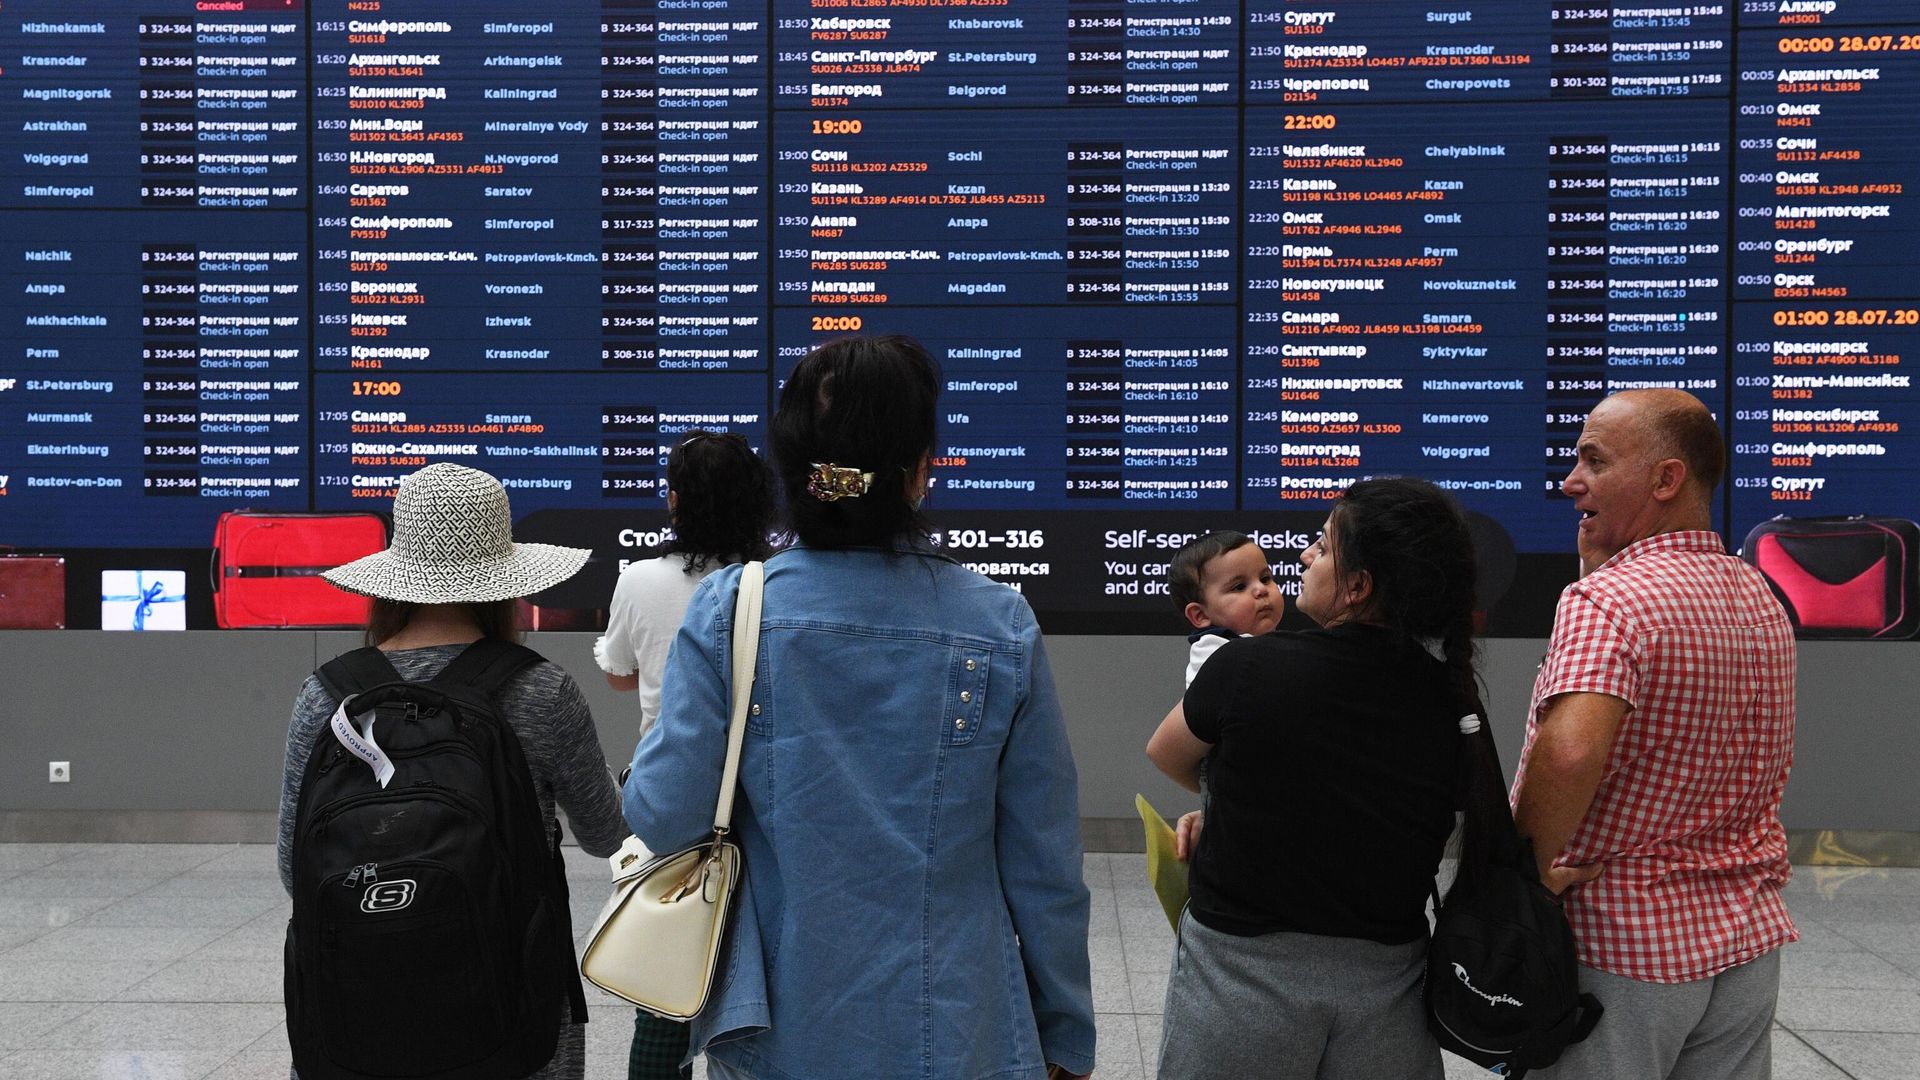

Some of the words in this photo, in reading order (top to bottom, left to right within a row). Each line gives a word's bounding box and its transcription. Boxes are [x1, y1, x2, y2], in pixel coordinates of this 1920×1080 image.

[196, 1, 243, 10] Cancelled
[1779, 0, 1836, 14] Алжир
[1203, 17, 1231, 25] 14:30
[1285, 11, 1335, 25] Сургут
[1427, 11, 1471, 23] Surgut
[22, 23, 105, 33] Nizhnekamsk
[152, 25, 192, 33] 324-364
[197, 23, 267, 34] Регистрация
[271, 25, 296, 33] идет
[317, 22, 345, 31] 16:15
[349, 20, 451, 34] Симферополь
[484, 23, 552, 35] Simferopol
[613, 24, 653, 32] 324-364
[659, 22, 729, 32] Регистрация
[733, 22, 758, 31] идет
[779, 19, 808, 28] 18:30
[811, 17, 890, 31] Хабаровск
[949, 19, 1023, 29] Khabarovsk
[197, 34, 238, 43] Check-in
[241, 36, 266, 44] open
[658, 33, 700, 41] Check-in
[703, 34, 727, 42] open
[1427, 45, 1494, 55] Krasnodar
[1779, 38, 1834, 52] 00:00
[811, 49, 937, 64] Санкт-Петербург
[949, 52, 1036, 63] St.Petersburg
[1285, 45, 1367, 61] Краснодар
[23, 56, 87, 65] Krasnodar
[349, 54, 440, 67] Архангельск
[484, 56, 562, 68] Arkhangelsk
[1564, 77, 1606, 87] 301-302
[1777, 69, 1879, 83] Архангельск
[812, 84, 882, 97] Белгород
[1284, 79, 1369, 92] Череповец
[1426, 78, 1510, 91] Cherepovets
[23, 89, 111, 100] Magnitogorsk
[350, 86, 446, 100] Калининград
[485, 89, 556, 100] Kaliningrad
[949, 85, 1006, 97] Belgorod
[1777, 103, 1820, 115] Омск
[23, 121, 86, 130] Astrakhan
[350, 119, 423, 133] Мин.Воды
[485, 121, 554, 133] Mineralnye
[558, 121, 588, 133] Vody
[813, 120, 862, 134] 19:00
[1285, 115, 1336, 129] 22:00
[1777, 137, 1816, 149] Сочи
[811, 150, 847, 161] Сочи
[948, 151, 982, 161] Sochi
[1283, 144, 1365, 157] Челябинск
[1425, 145, 1505, 158] Chelyabinsk
[24, 154, 88, 165] Volgograd
[350, 151, 434, 165] Н.Новгород
[485, 154, 558, 167] N.Novgorod
[1776, 172, 1819, 184] Омск
[812, 183, 863, 194] Казань
[949, 185, 985, 194] Kazan
[1283, 179, 1336, 190] Казань
[1425, 181, 1463, 189] Kazan
[24, 186, 93, 198] Simferopol
[350, 184, 409, 198] Саратов
[485, 187, 532, 196] Saratov
[1283, 212, 1323, 223] Омск
[1424, 213, 1461, 223] Omsk
[1776, 206, 1889, 219] Магнитогорск
[350, 216, 452, 230] Симферополь
[485, 219, 553, 231] Simferopol
[614, 220, 654, 228] 317-323
[811, 215, 856, 226] Анапа
[948, 218, 988, 229] Anapa
[1283, 245, 1333, 259] Пермь
[1424, 247, 1458, 256] Perm
[1775, 238, 1853, 254] Оренбург
[26, 251, 71, 260] Nalchik
[351, 251, 477, 265] Петропавловск-Кмч.
[486, 253, 598, 263] Petropavlovsk-Kmch.
[812, 250, 940, 264] Петропавловск-Кмч.
[948, 251, 1063, 262] Petropavlovsk-Kmch.
[811, 281, 875, 293] Магадан
[1283, 278, 1384, 292] Новокузнецк
[1424, 279, 1516, 290] Novokuznetsk
[1774, 274, 1814, 288] Орск
[26, 284, 65, 295] Anapa
[351, 281, 417, 295] Воронеж
[485, 284, 543, 293] Voronezh
[948, 283, 1006, 294] Magadan
[27, 316, 106, 325] Makhachkala
[351, 314, 407, 325] Ижевск
[486, 317, 531, 326] Izhevsk
[813, 317, 861, 330] 20:00
[1282, 311, 1339, 325] Самара
[1423, 314, 1471, 323] Samara
[1774, 311, 1829, 325] 01:00
[27, 348, 59, 357] Perm
[352, 346, 430, 362] Краснодар
[486, 349, 549, 358] Krasnodar
[614, 350, 654, 358] 308-316
[779, 347, 807, 356] 20:05
[948, 348, 1021, 360] Kaliningrad
[1282, 344, 1366, 361] Сыктывкар
[1423, 346, 1487, 359] Syktyvkar
[1774, 341, 1868, 356] Красноярск
[27, 380, 113, 392] St.Petersburg
[1282, 377, 1403, 391] Нижневартовск
[1423, 380, 1523, 390] Nizhnevartovsk
[1772, 374, 1910, 387] Ханты-Мансийск
[353, 381, 401, 395] 17:00
[948, 381, 1017, 393] Simferopol
[27, 413, 92, 422] Murmansk
[352, 411, 406, 424] Самара
[486, 414, 531, 423] Samara
[948, 414, 969, 423] Ufa
[1282, 411, 1359, 426] Кемерово
[1423, 414, 1489, 423] Kemerovo
[1773, 408, 1879, 423] Новосибирск
[28, 445, 108, 457] Ekaterinburg
[352, 443, 477, 454] Южно-Сахалинск
[486, 446, 597, 455] Yuzhno-Sakhalinsk
[948, 446, 1025, 460] Krasnoyarsk
[1281, 444, 1360, 460] Волгоград
[1422, 446, 1489, 458] Volgograd
[1772, 442, 1885, 457] Симферополь
[28, 477, 122, 486] Rostov-on-Don
[502, 478, 572, 490] Petersburg
[947, 479, 1035, 491] St.Petersburg
[1125, 480, 1190, 493] Регистрация
[1200, 480, 1228, 488] 14:30
[1439, 479, 1522, 490] stov-on-Don
[1772, 477, 1825, 491] Сургут
[1125, 490, 1166, 498] Check-in
[1104, 561, 1137, 575] You
[1268, 561, 1302, 576] rint
[1104, 580, 1139, 595] and
[338, 722, 378, 762] APPROVED
[1451, 962, 1524, 1007] Champion
